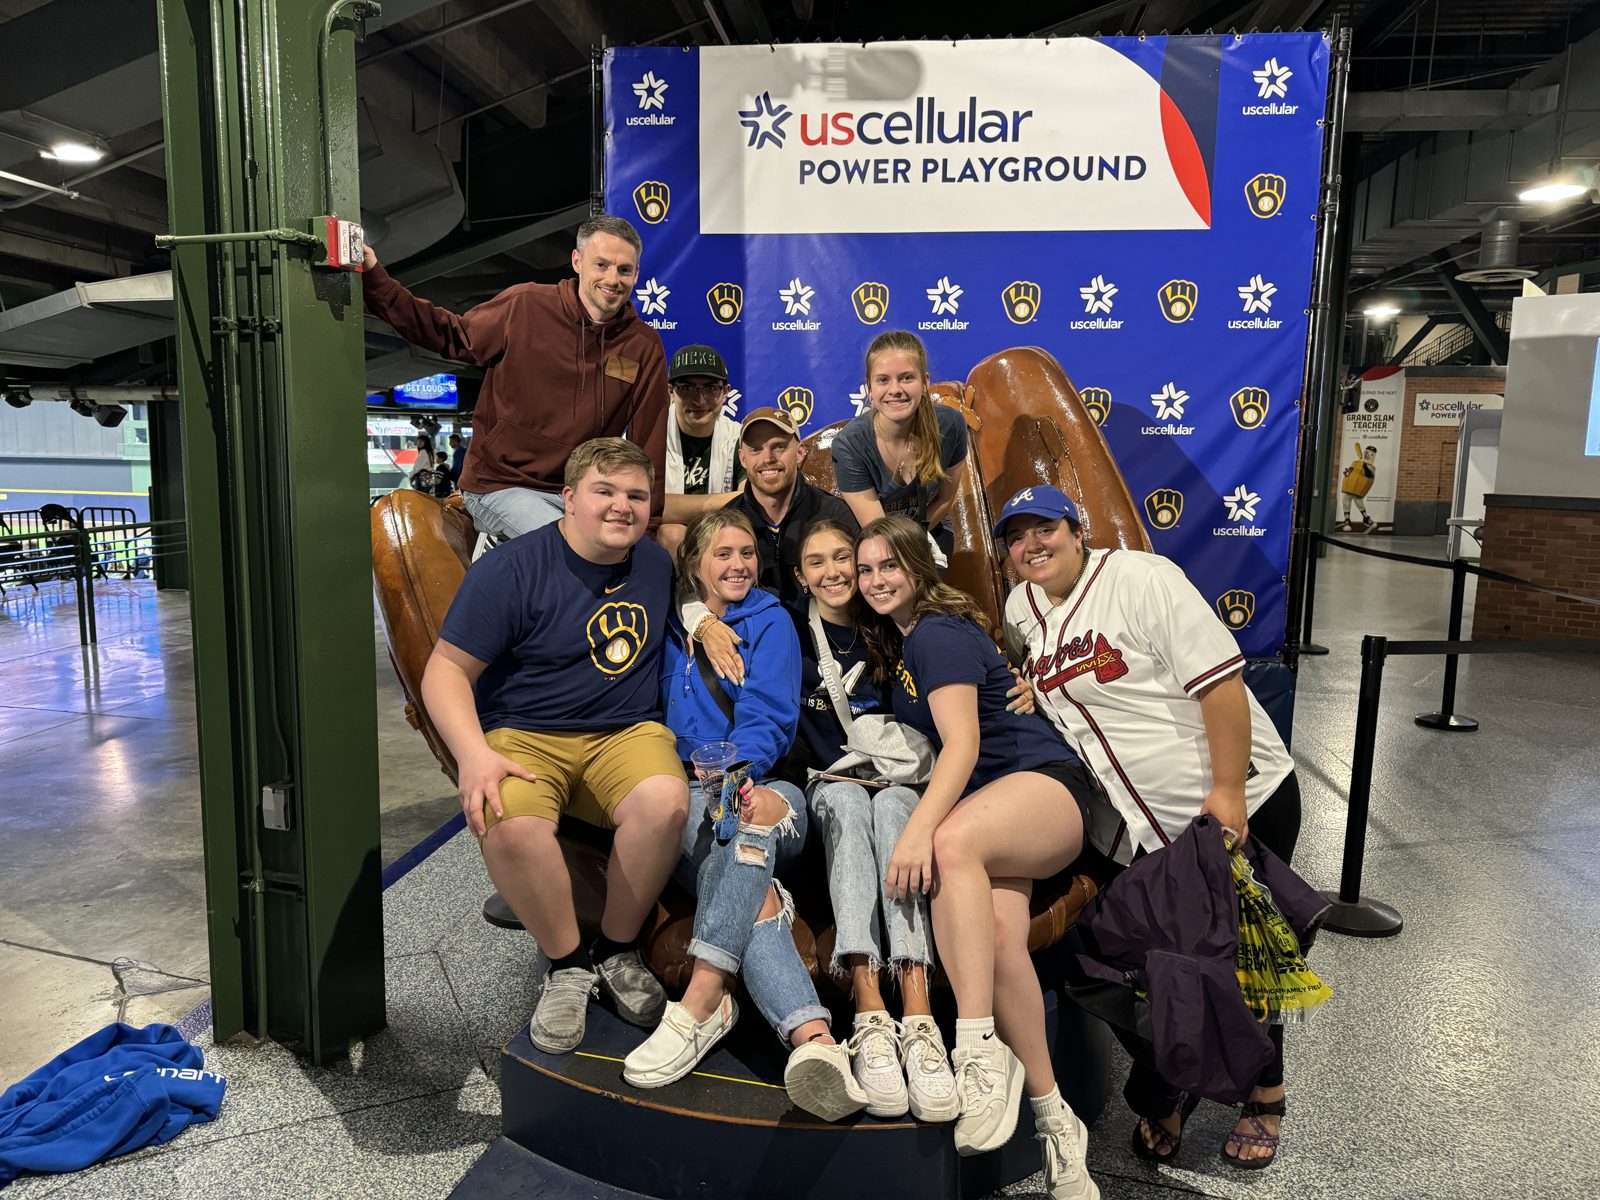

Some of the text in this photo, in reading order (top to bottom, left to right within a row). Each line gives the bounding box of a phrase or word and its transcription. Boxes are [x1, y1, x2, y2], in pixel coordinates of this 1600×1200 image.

[1242, 102, 1299, 116] uscellular
[626, 113, 676, 126] uscellular
[800, 96, 1033, 146] uscellular
[799, 155, 1147, 185] POWER PLAYGROUND
[771, 318, 822, 331] uscellular
[917, 318, 970, 331] uscellular
[1070, 317, 1124, 330] uscellular
[1227, 317, 1283, 329] uscellular
[674, 350, 717, 369] BUCKS
[405, 384, 443, 392] GET LOUD
[1141, 424, 1196, 436] uscellular
[1353, 421, 1387, 429] TEACHER
[1212, 525, 1267, 537] uscellular
